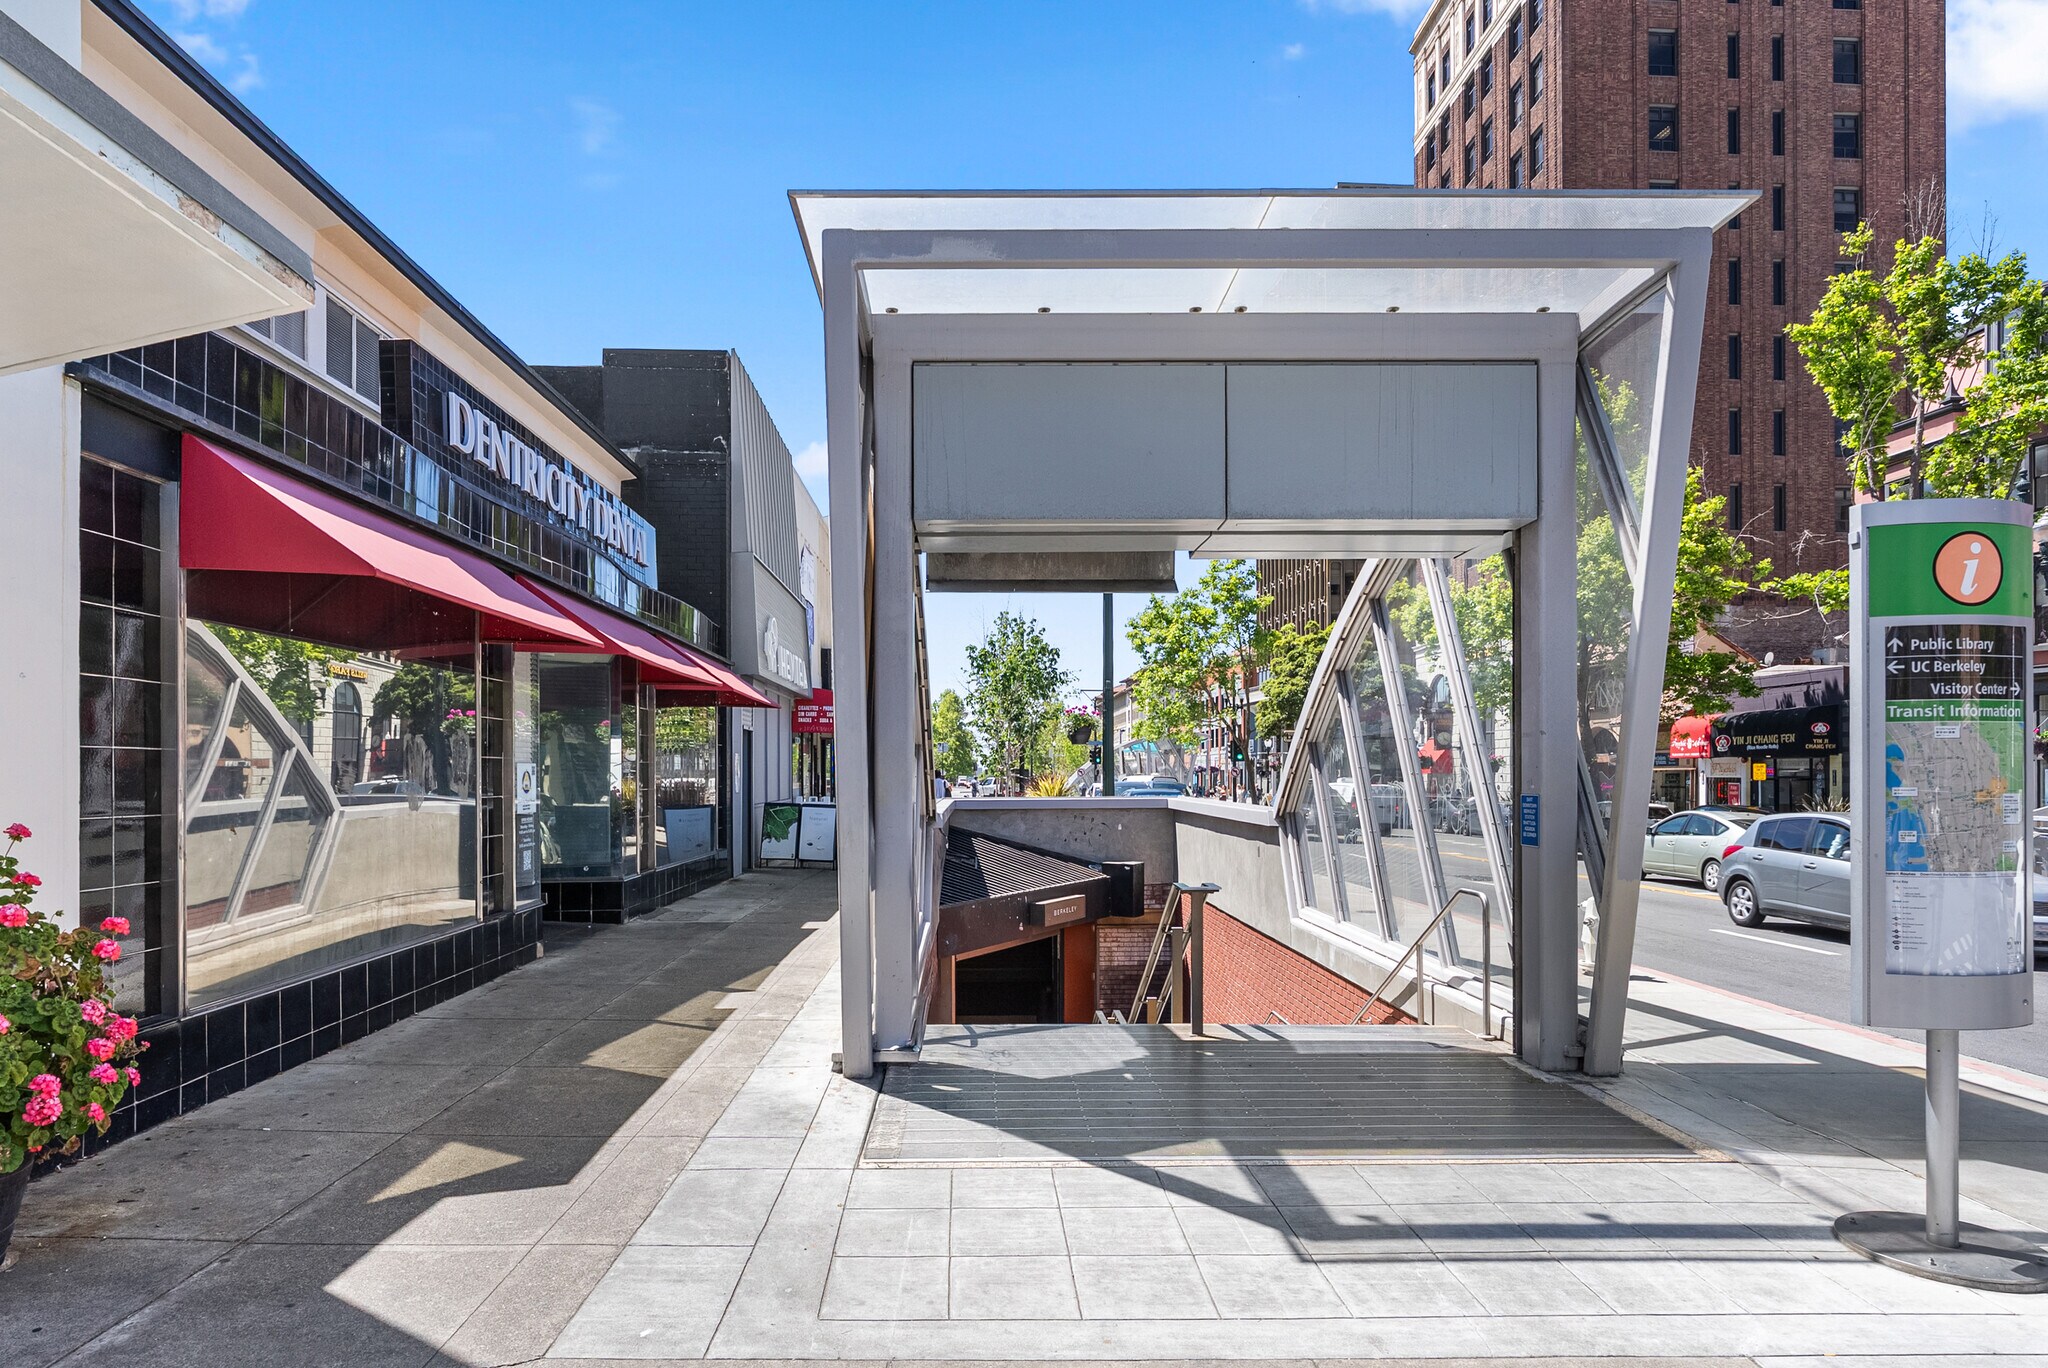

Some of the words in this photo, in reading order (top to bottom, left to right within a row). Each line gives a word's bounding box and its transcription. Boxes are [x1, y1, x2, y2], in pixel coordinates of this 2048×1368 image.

[448, 391, 591, 529] DENTRICITY
[1910, 637, 1953, 651] Public
[1956, 637, 1994, 653] Library
[777, 645, 808, 689] HEYTEA
[1911, 660, 1931, 673] UC
[1933, 659, 1986, 675] Berkeley
[1930, 682, 1973, 695] Visitor
[1975, 682, 2008, 695] Center
[1887, 704, 1946, 718] Transit
[1950, 704, 2021, 718] Information
[1732, 735, 1744, 746] YIN
[1745, 735, 1752, 745] JI
[1753, 734, 1779, 745] CHANG
[1780, 733, 1796, 744] FEN
[1054, 906, 1077, 916] BERKELEY
